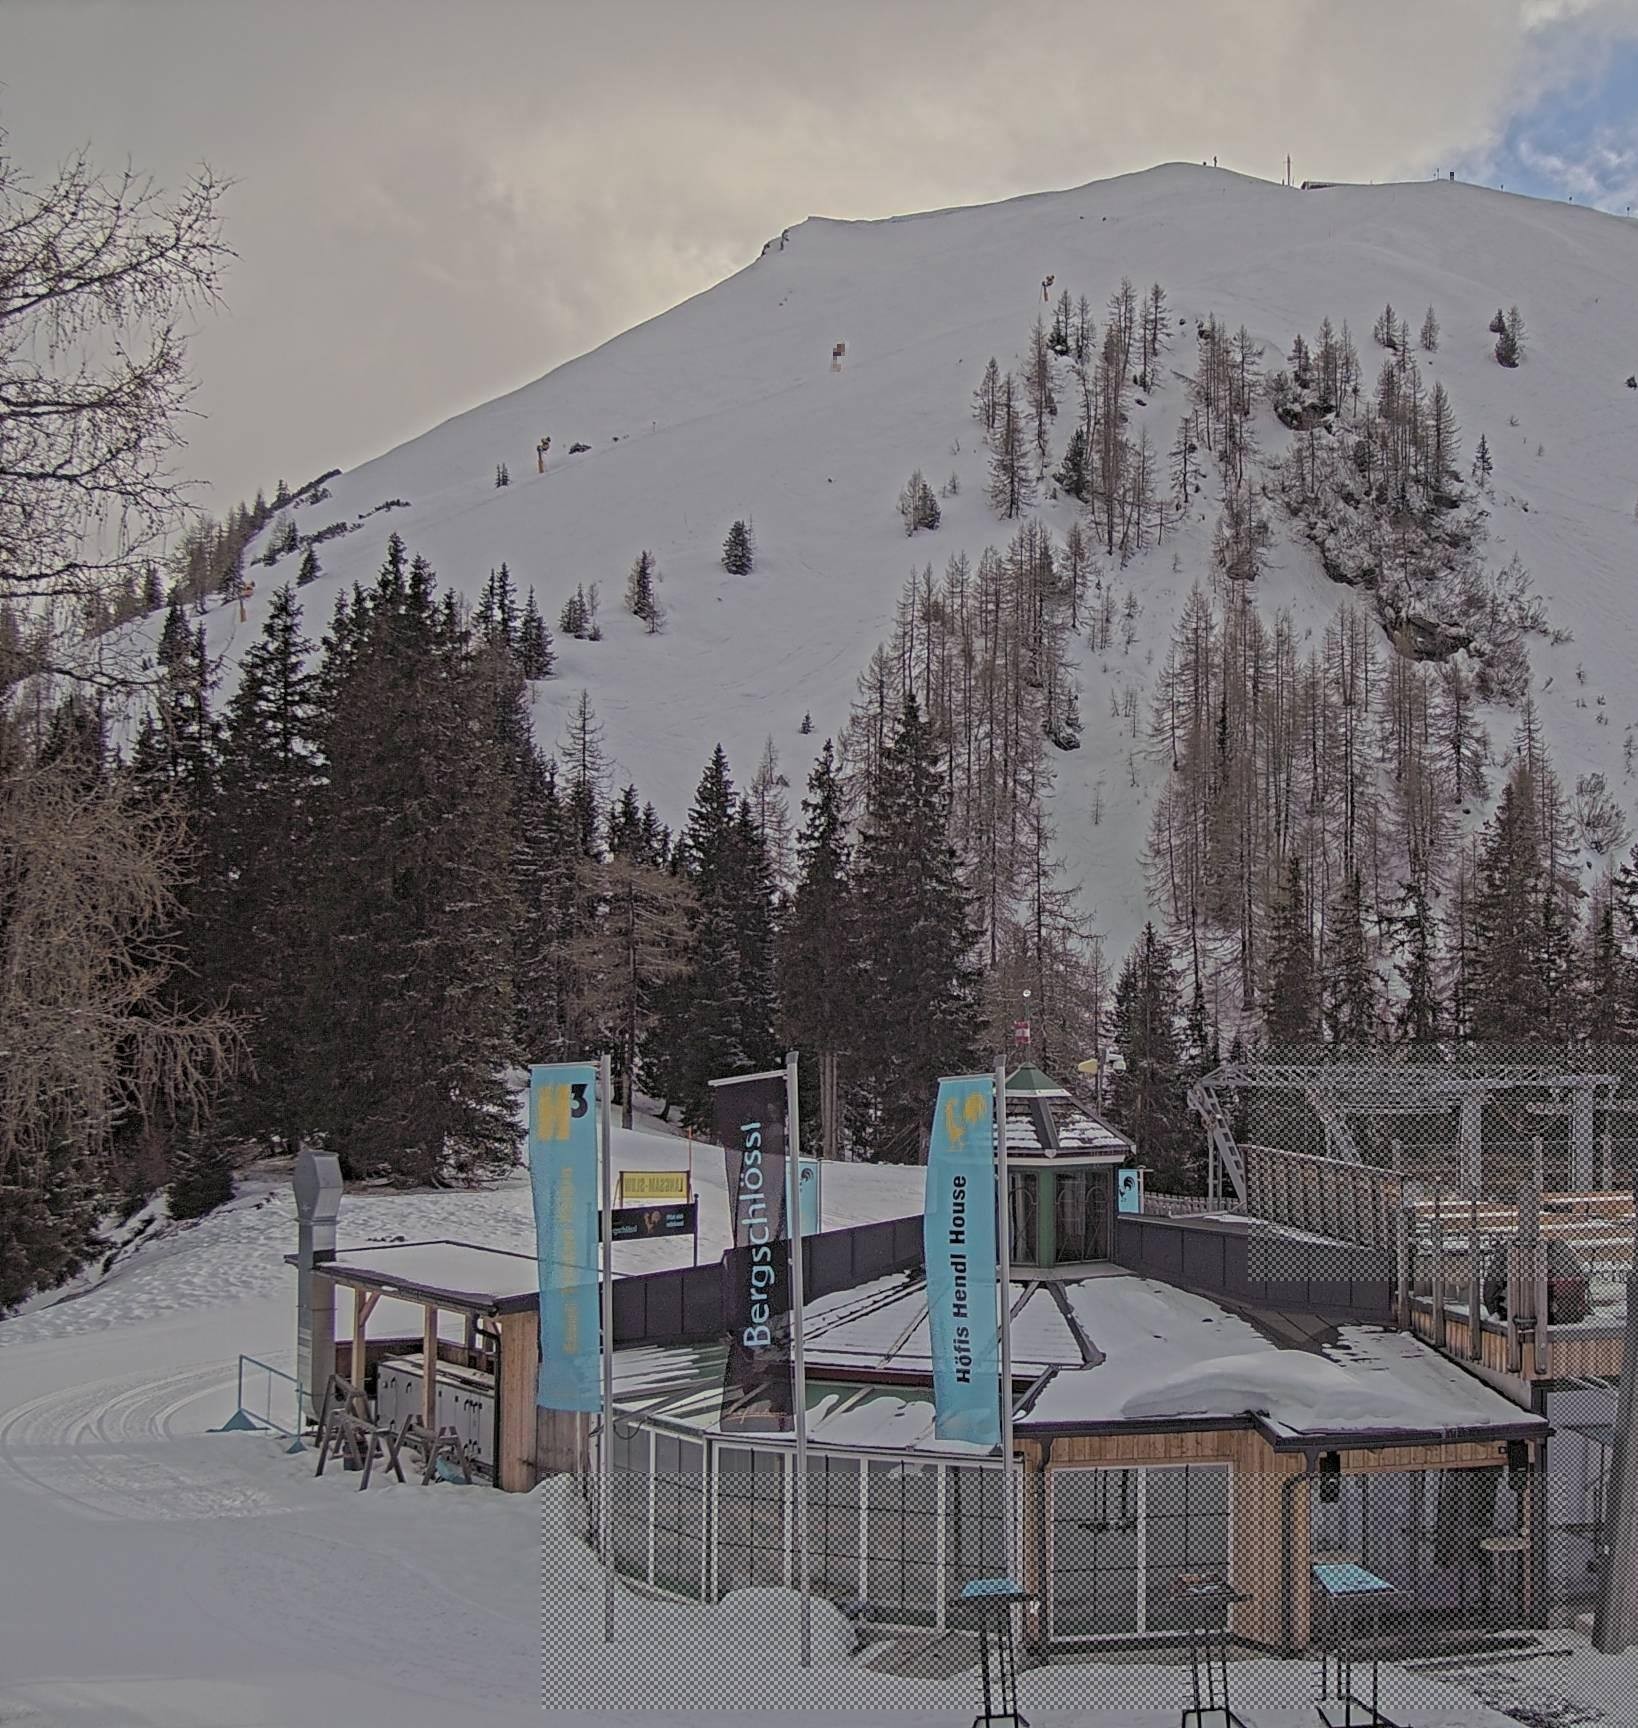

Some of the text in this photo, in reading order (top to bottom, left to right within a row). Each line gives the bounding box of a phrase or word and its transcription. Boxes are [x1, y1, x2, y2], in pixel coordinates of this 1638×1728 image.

[740, 1122, 775, 1347] Bergschlössl
[950, 1175, 971, 1384] Höfis Hendl House
